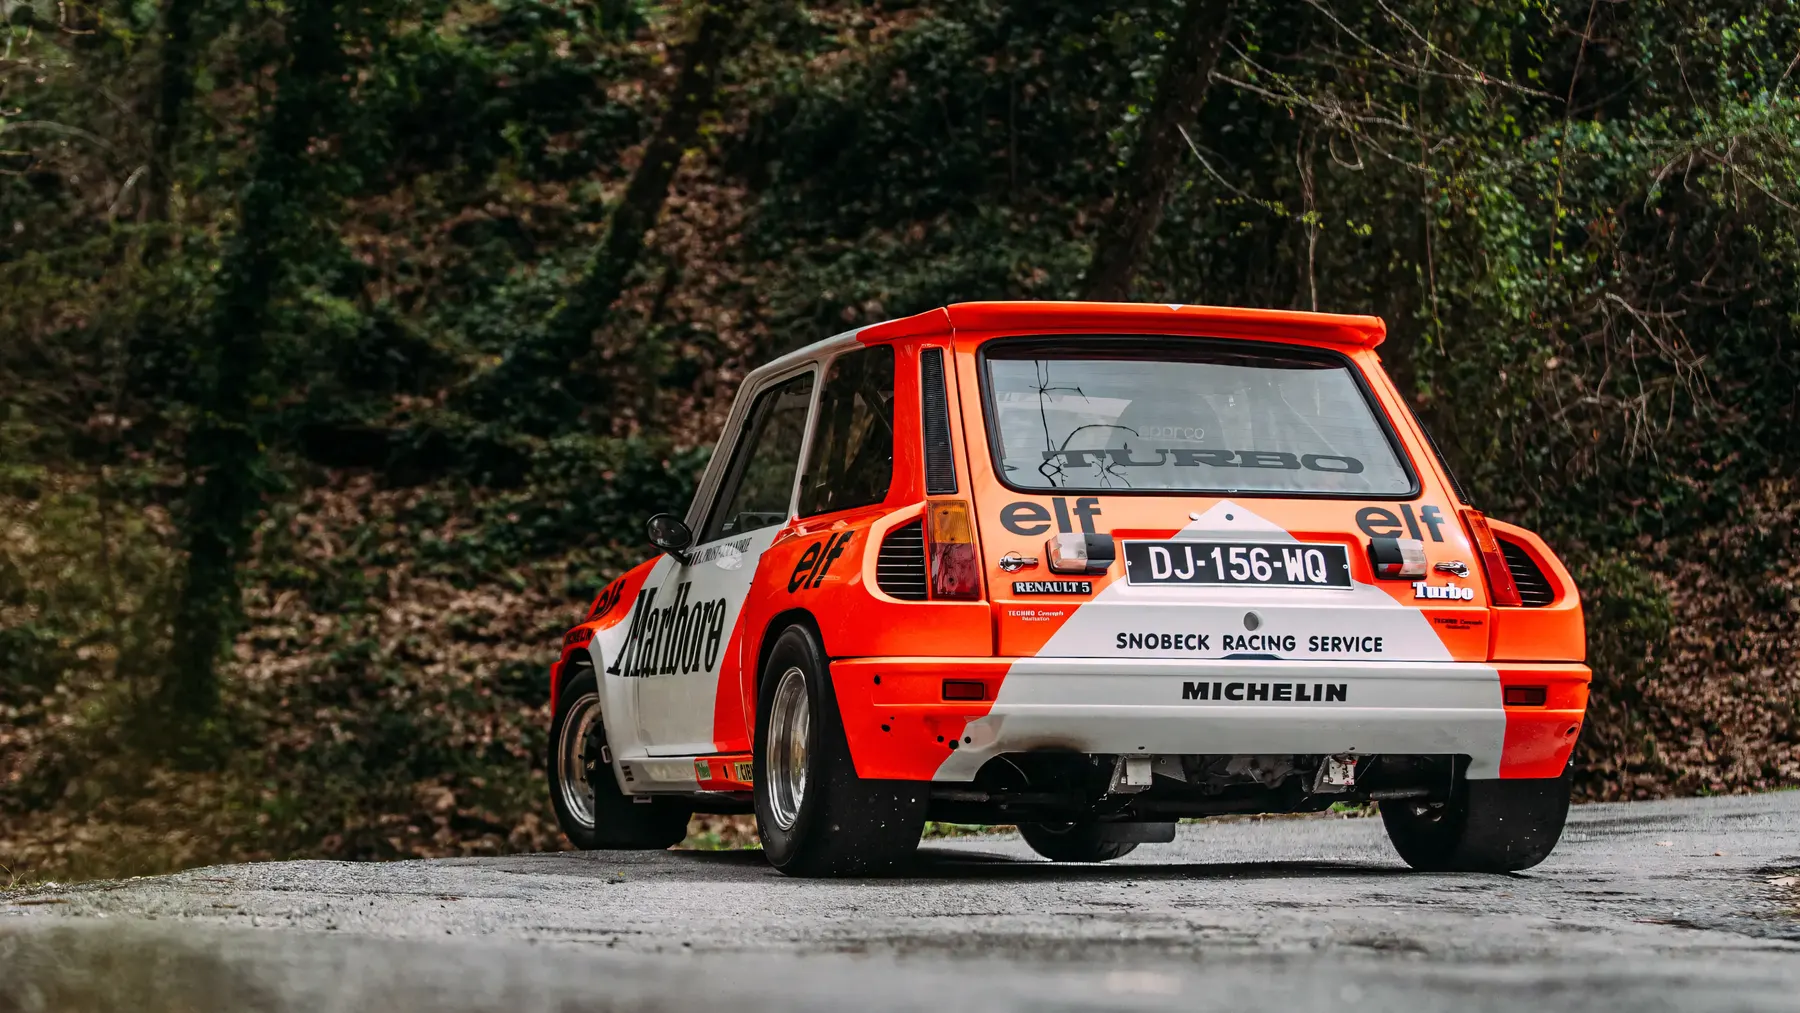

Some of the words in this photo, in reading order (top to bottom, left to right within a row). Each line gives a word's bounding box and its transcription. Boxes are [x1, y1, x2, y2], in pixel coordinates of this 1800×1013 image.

[1042, 449, 1364, 474] TURBO
[1000, 497, 1102, 536] elf
[1355, 504, 1445, 542] elf
[787, 530, 855, 594] elf
[1148, 546, 1328, 583] DJ-156-WQ
[1015, 582, 1079, 593] RENAULT
[1081, 582, 1090, 593] 5
[1412, 581, 1474, 600] Turbo
[606, 581, 726, 678] Marlboro
[1115, 632, 1210, 650] SNOBECK
[1222, 634, 1296, 652] RACING
[1308, 636, 1383, 653] SERVICE
[1182, 681, 1348, 701] MICHELIN
